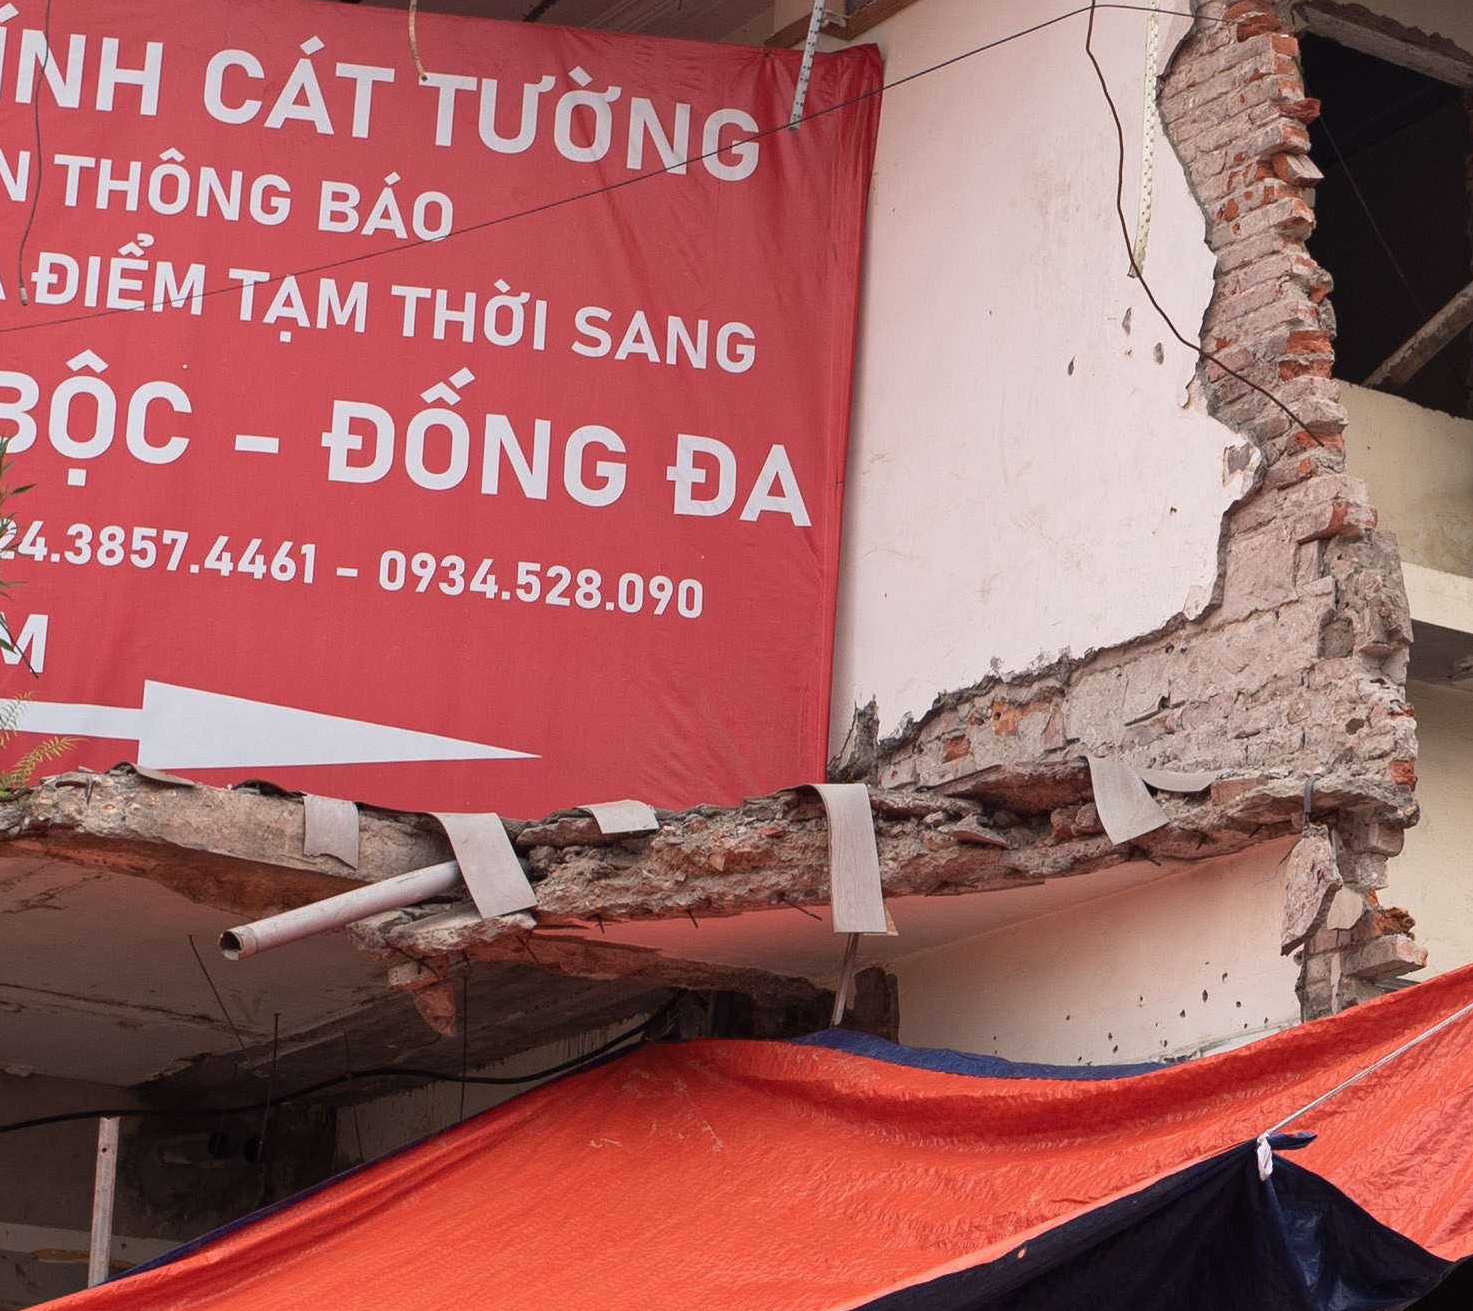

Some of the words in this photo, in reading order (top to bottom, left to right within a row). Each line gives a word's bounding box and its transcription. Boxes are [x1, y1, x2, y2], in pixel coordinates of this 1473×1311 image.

[205, 36, 395, 138] CÁT
[419, 66, 760, 182] TƯỜNG
[54, 148, 291, 226] THÔNG
[318, 172, 453, 242] BÁO
[31, 233, 205, 316] ĐIỂM
[229, 268, 368, 342] TẠM
[392, 278, 546, 350] THỜI
[571, 306, 756, 373] SANG
[235, 435, 279, 453] -
[322, 366, 626, 507] ĐỐNG
[667, 434, 811, 527] ĐA
[379, 549, 703, 619] 0934.528.090
